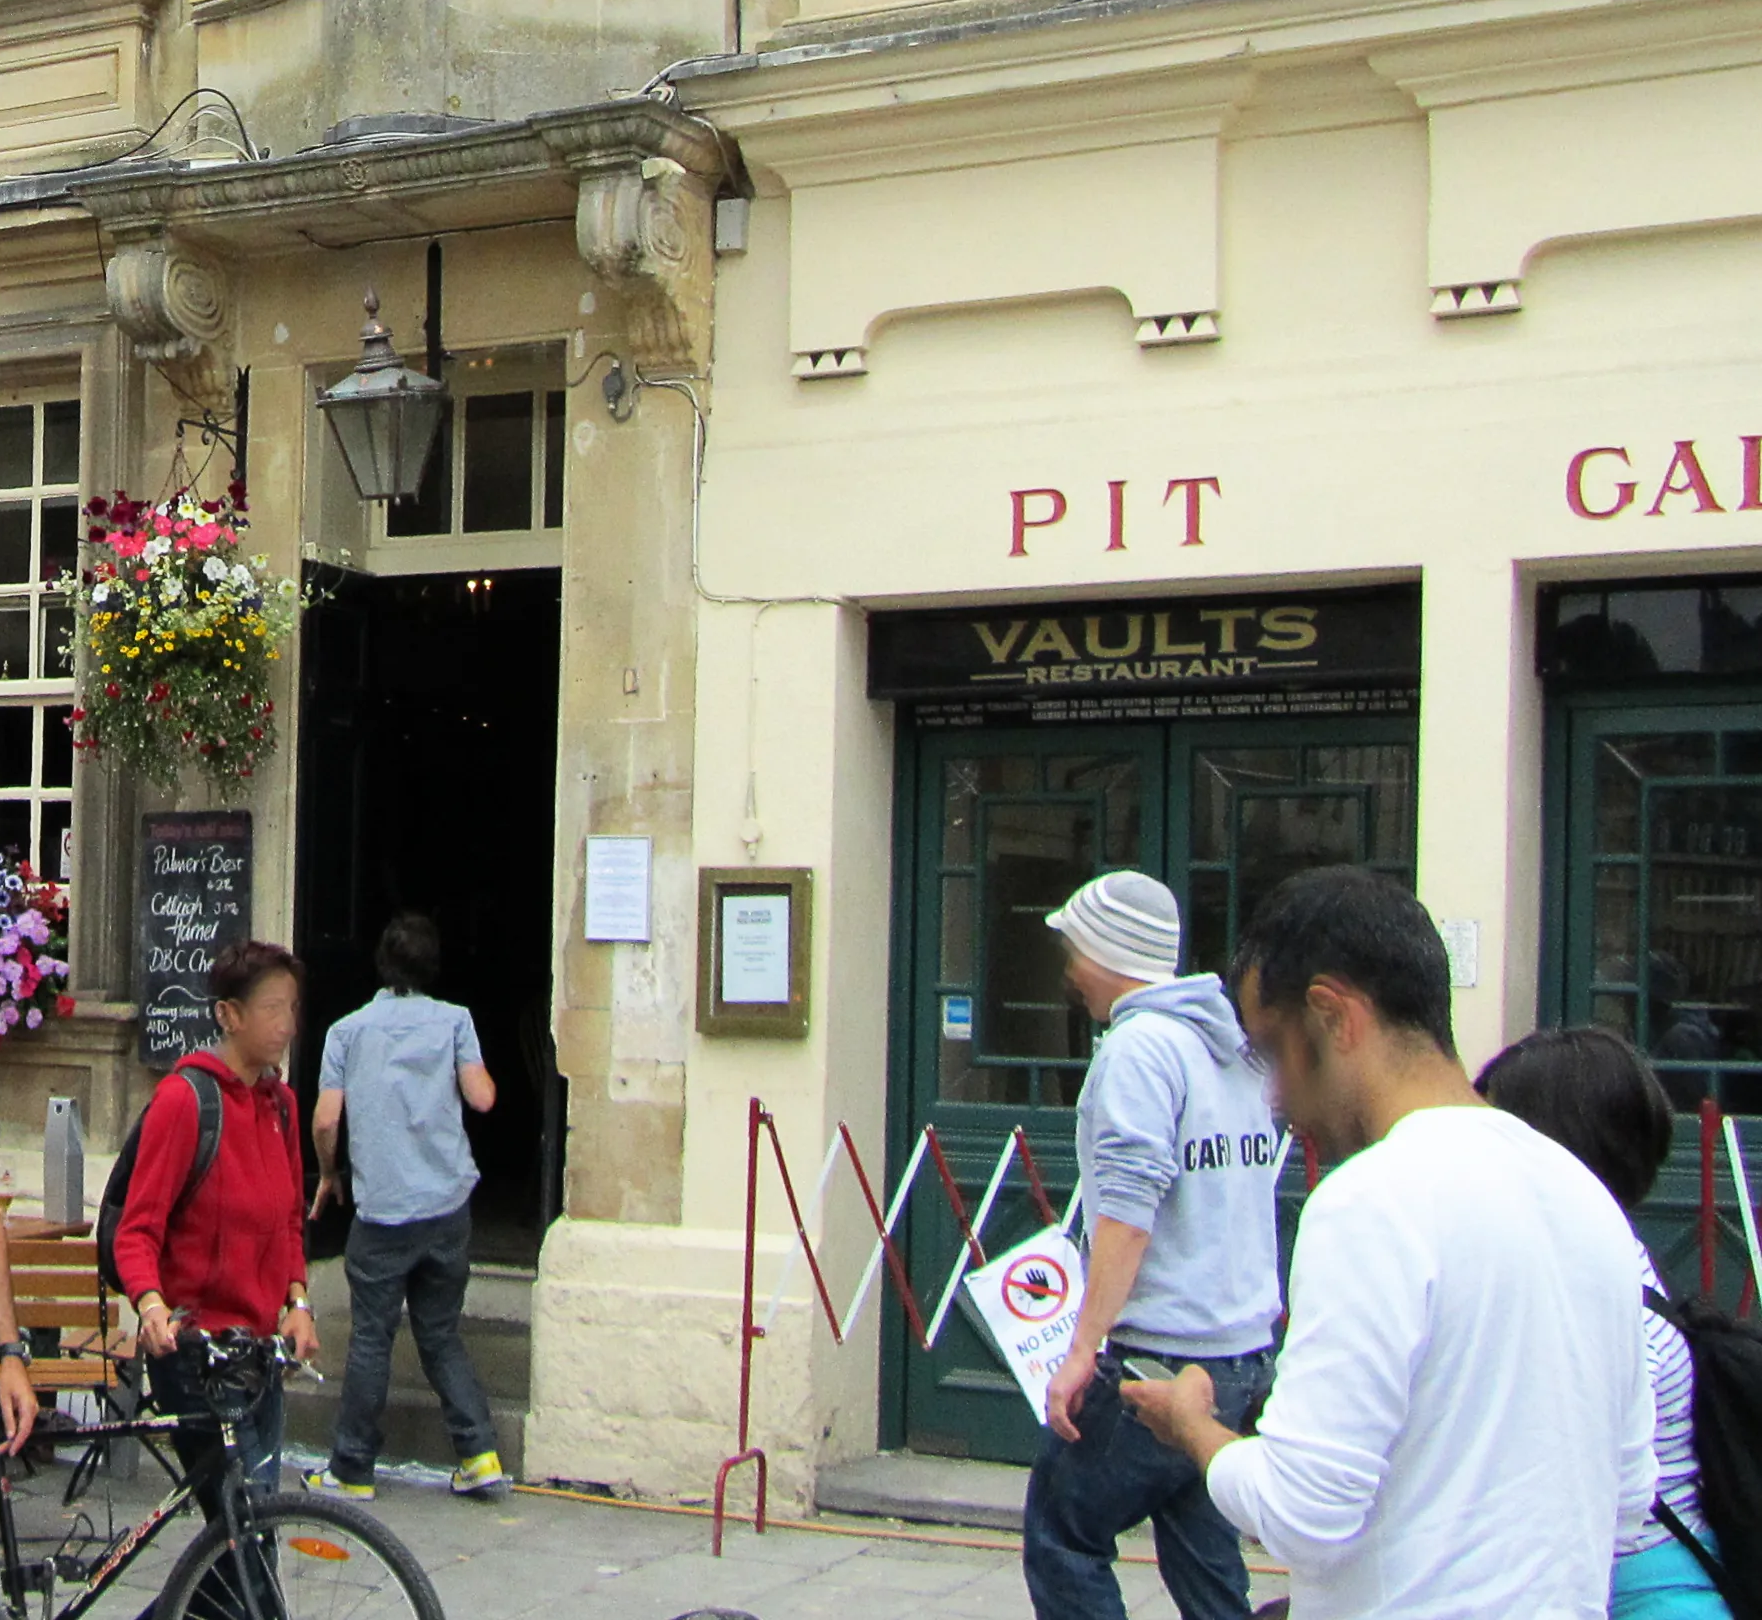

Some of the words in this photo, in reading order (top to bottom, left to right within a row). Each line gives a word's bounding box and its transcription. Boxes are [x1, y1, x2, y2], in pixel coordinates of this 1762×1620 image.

[1007, 476, 1223, 558] PIT
[971, 607, 1319, 664] VAULTS
[1025, 656, 1259, 685] RESTAURANT
[153, 844, 207, 875] Palmer's
[207, 844, 245, 874] Best
[1016, 1336, 1040, 1357] NO
